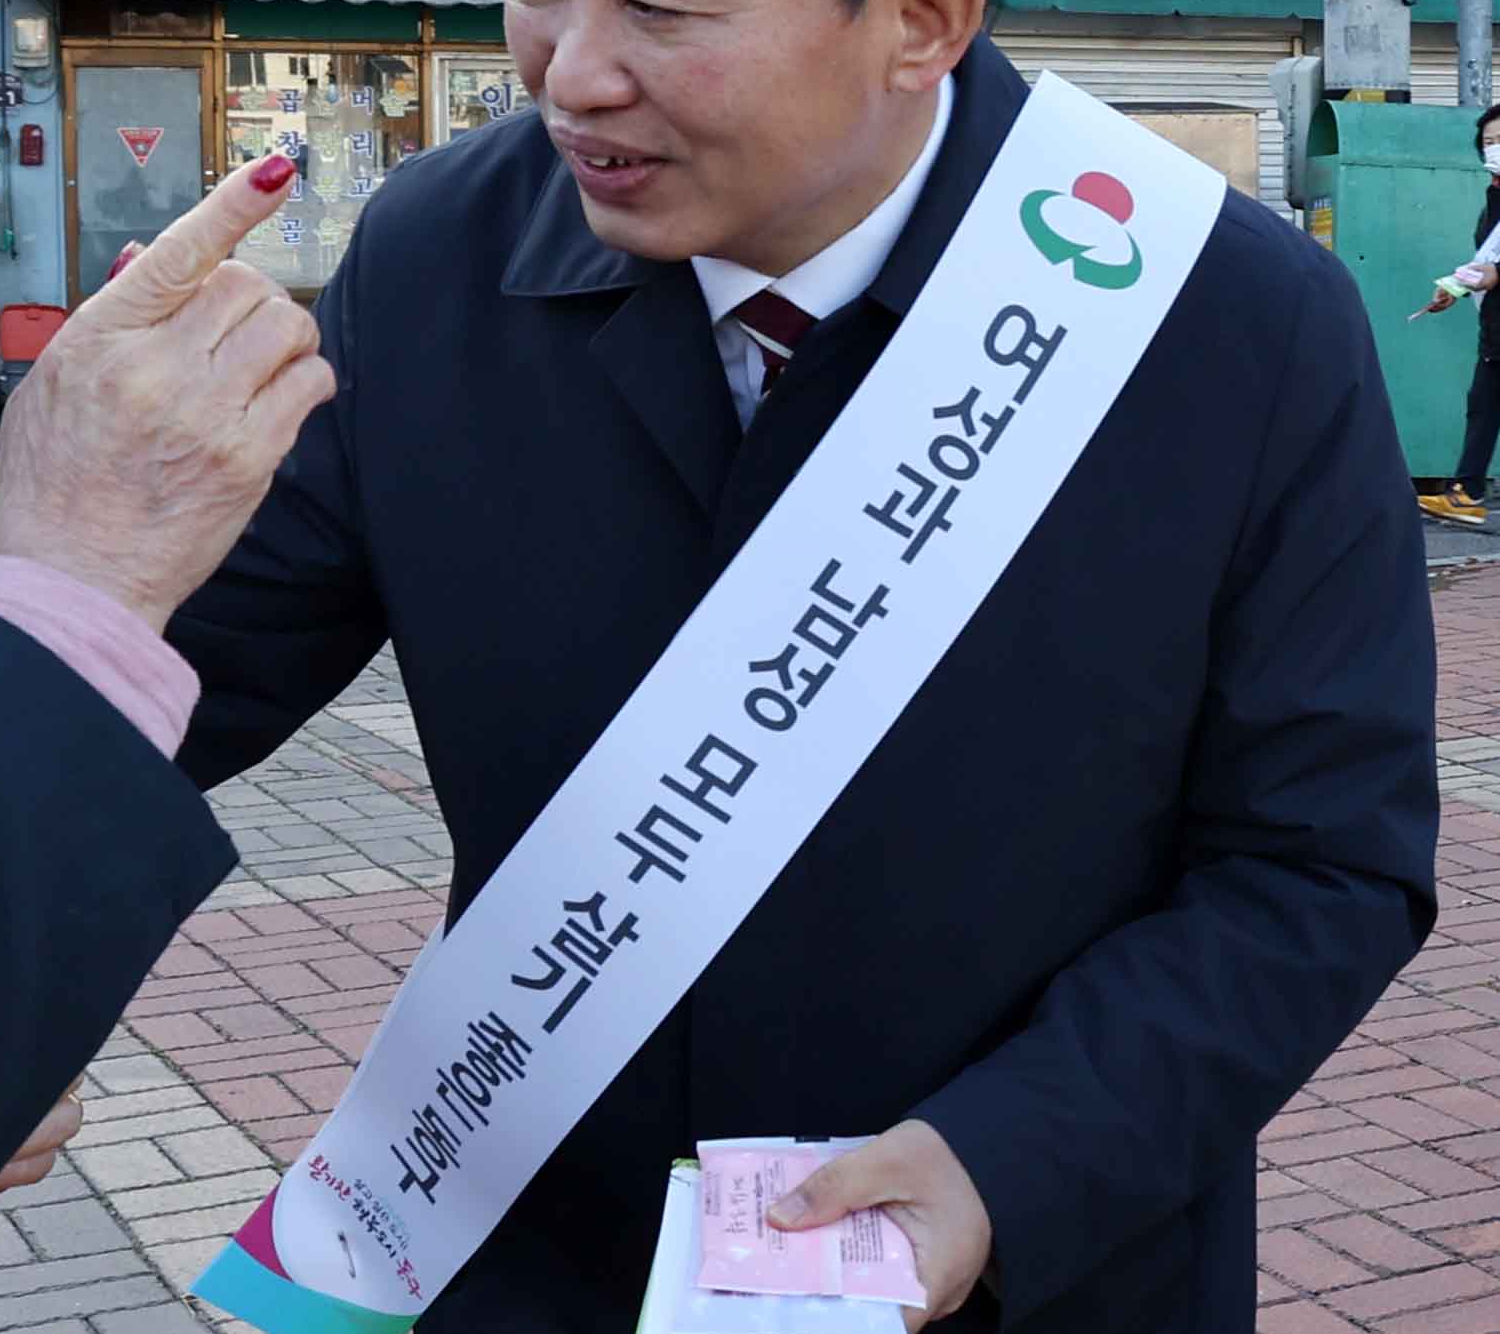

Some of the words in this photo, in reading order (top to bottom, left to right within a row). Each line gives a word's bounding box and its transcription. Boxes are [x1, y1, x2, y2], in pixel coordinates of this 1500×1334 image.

[864, 304, 1068, 564] 여성과
[744, 559, 890, 732] 남성
[615, 734, 758, 884] 모두
[511, 892, 640, 1034] 살기
[436, 1011, 533, 1132] 좋은
